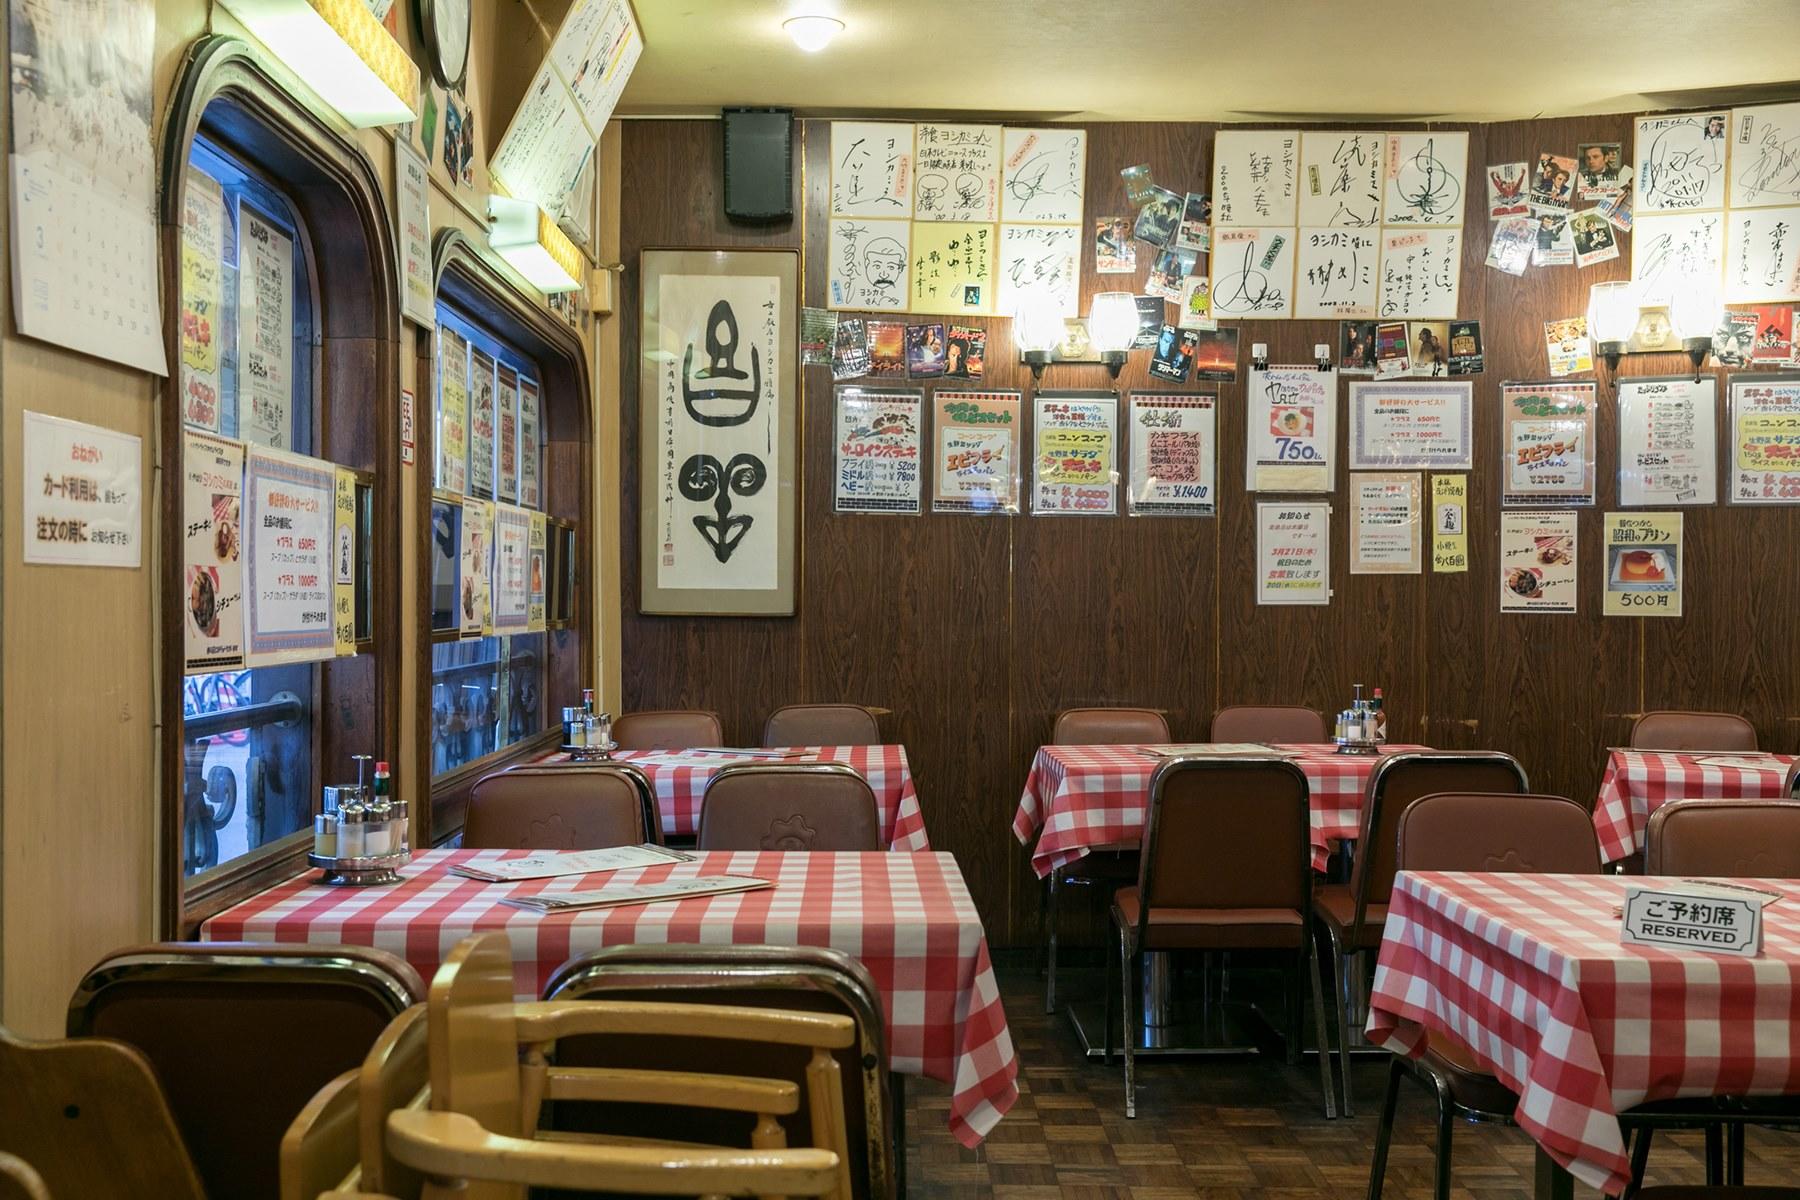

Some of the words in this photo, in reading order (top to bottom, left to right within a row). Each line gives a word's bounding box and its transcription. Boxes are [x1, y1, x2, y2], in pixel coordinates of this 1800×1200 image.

[1058, 433, 1107, 443] コーンスープ
[1151, 431, 1200, 440] カキフライ
[71, 442, 104, 464] おねがい
[897, 460, 917, 471] 5200
[897, 471, 916, 482] 7800
[1278, 511, 1312, 520] お知らせ
[36, 516, 89, 545] 注文の時に
[1612, 528, 1671, 542] 昭和のプリン
[1620, 592, 1669, 607] 500円
[1646, 899, 1737, 927] ご予約席
[1641, 922, 1737, 945] RESERVED
